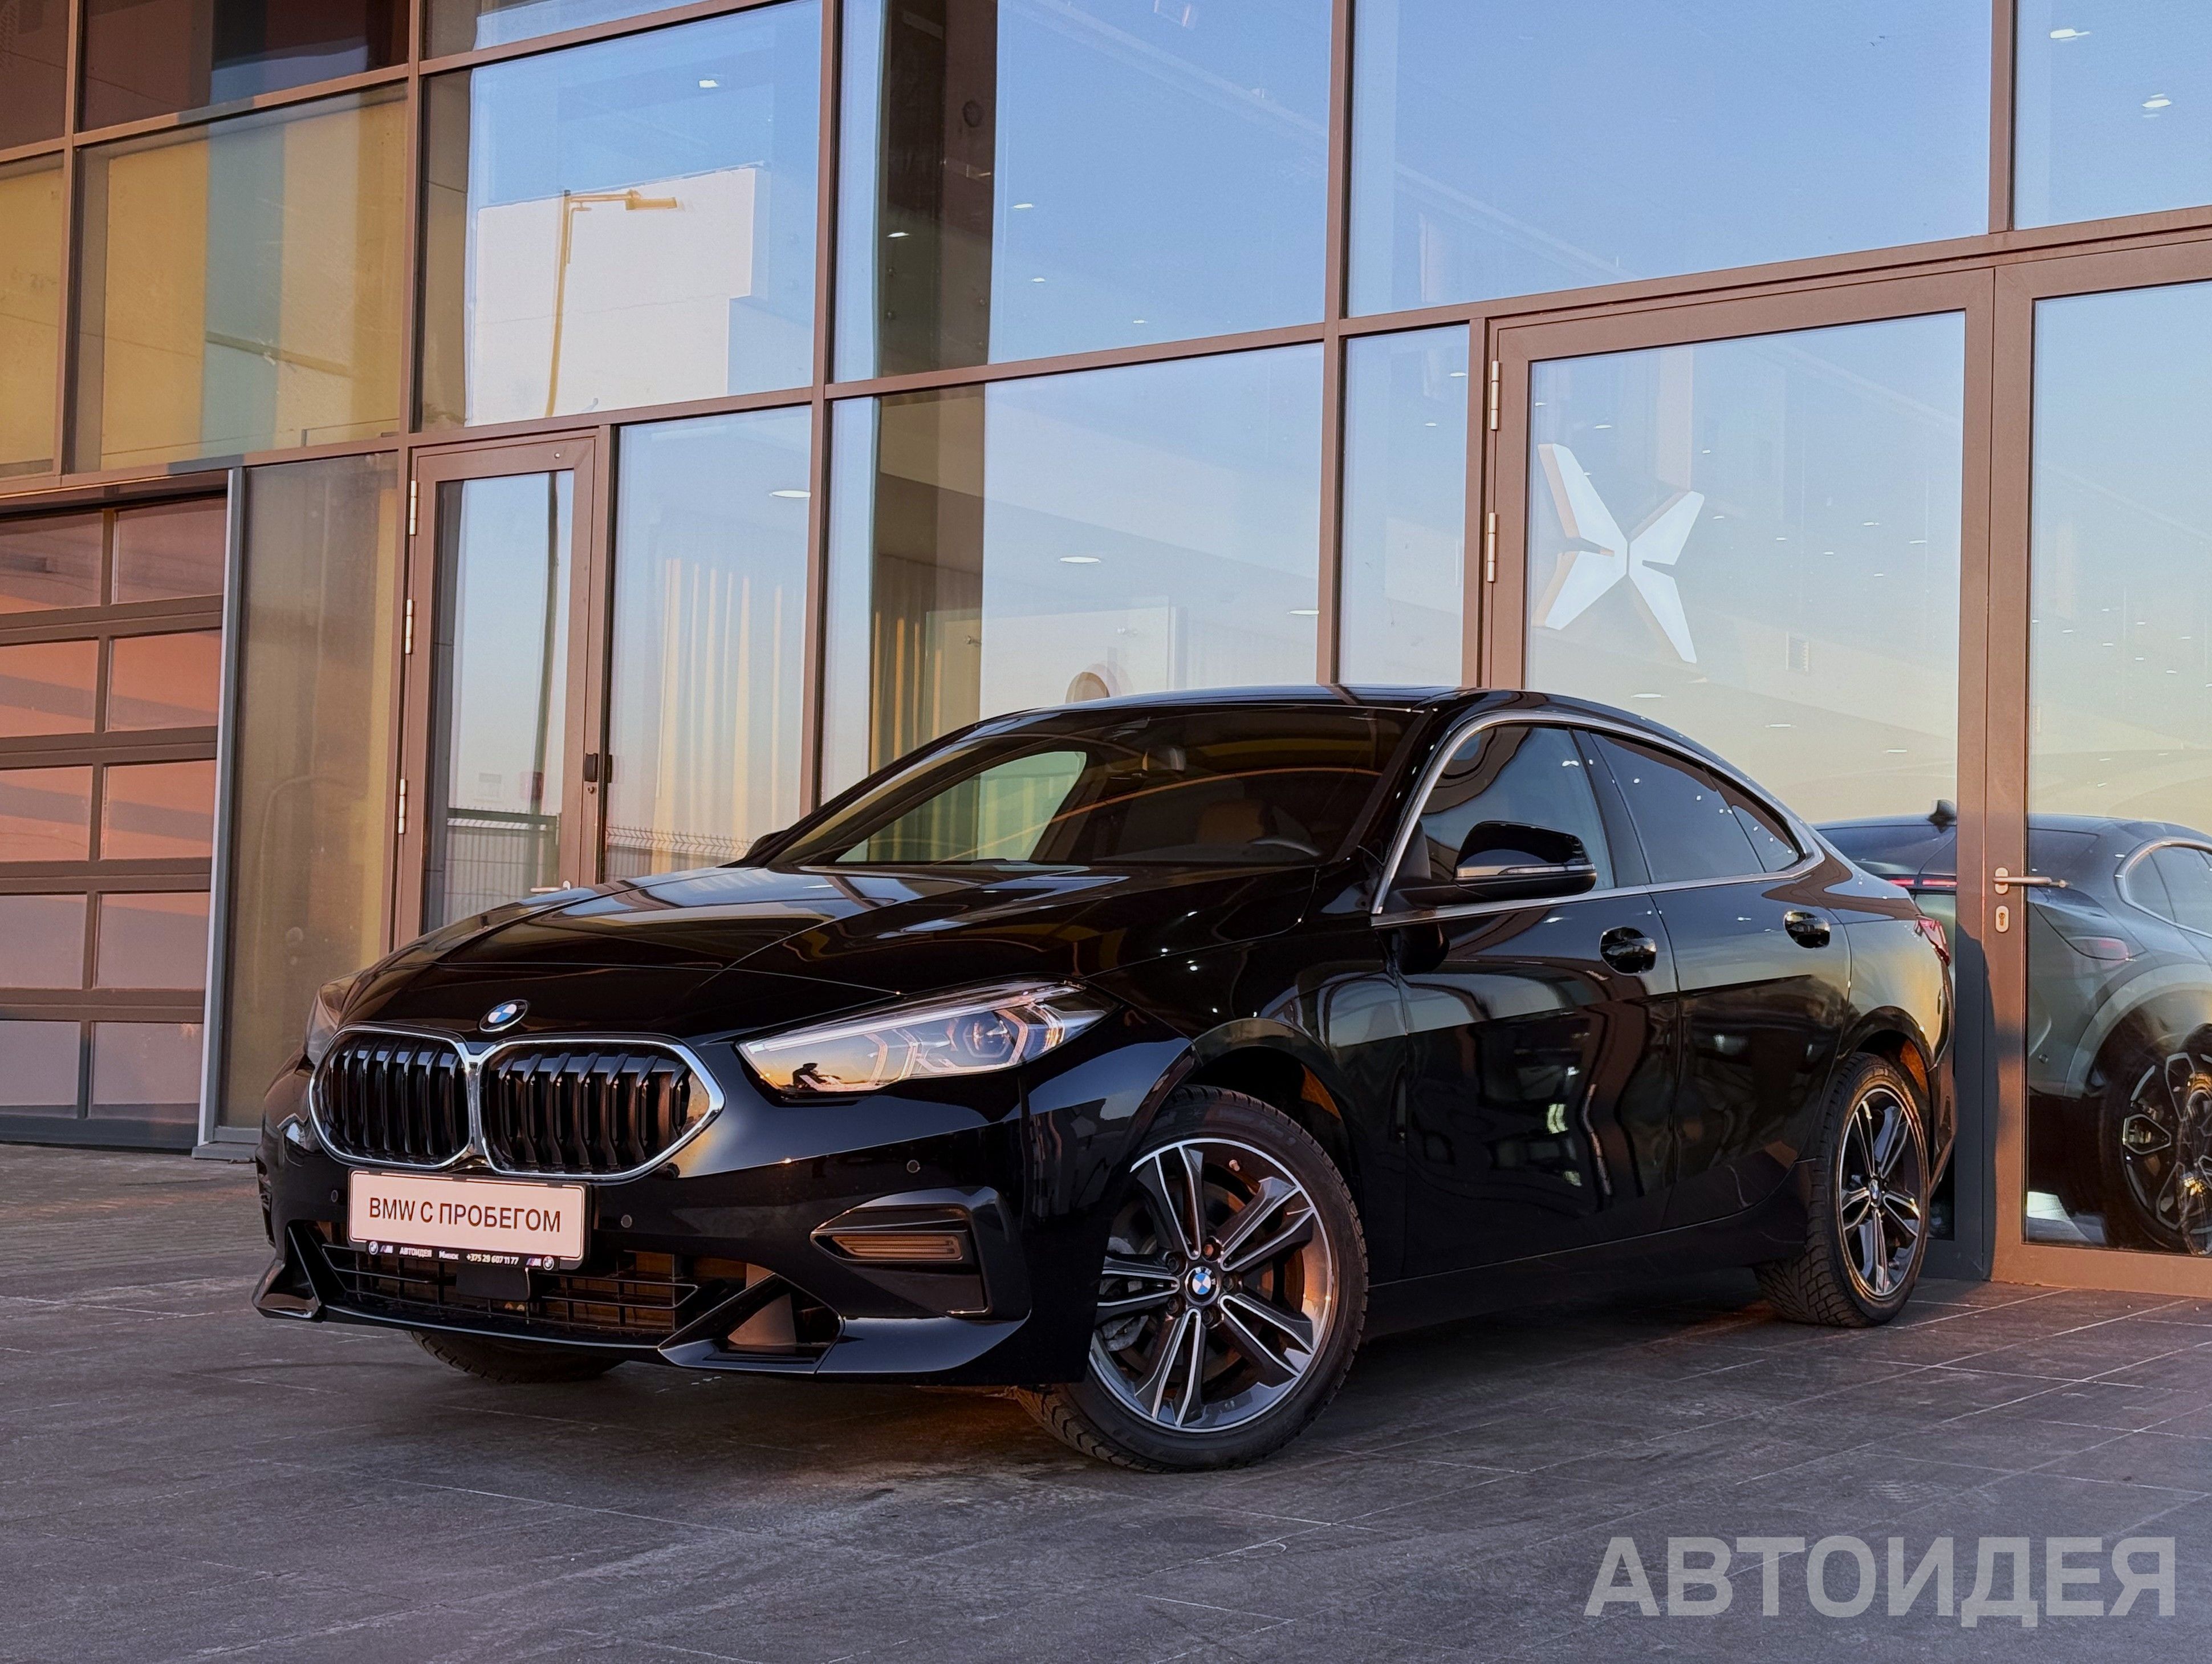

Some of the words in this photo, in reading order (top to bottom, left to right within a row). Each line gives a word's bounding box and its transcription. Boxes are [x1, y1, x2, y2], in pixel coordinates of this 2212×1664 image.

[369, 1197, 415, 1221] BMW
[420, 1201, 433, 1223] С
[439, 1203, 561, 1233] ПРОБЕГОМ
